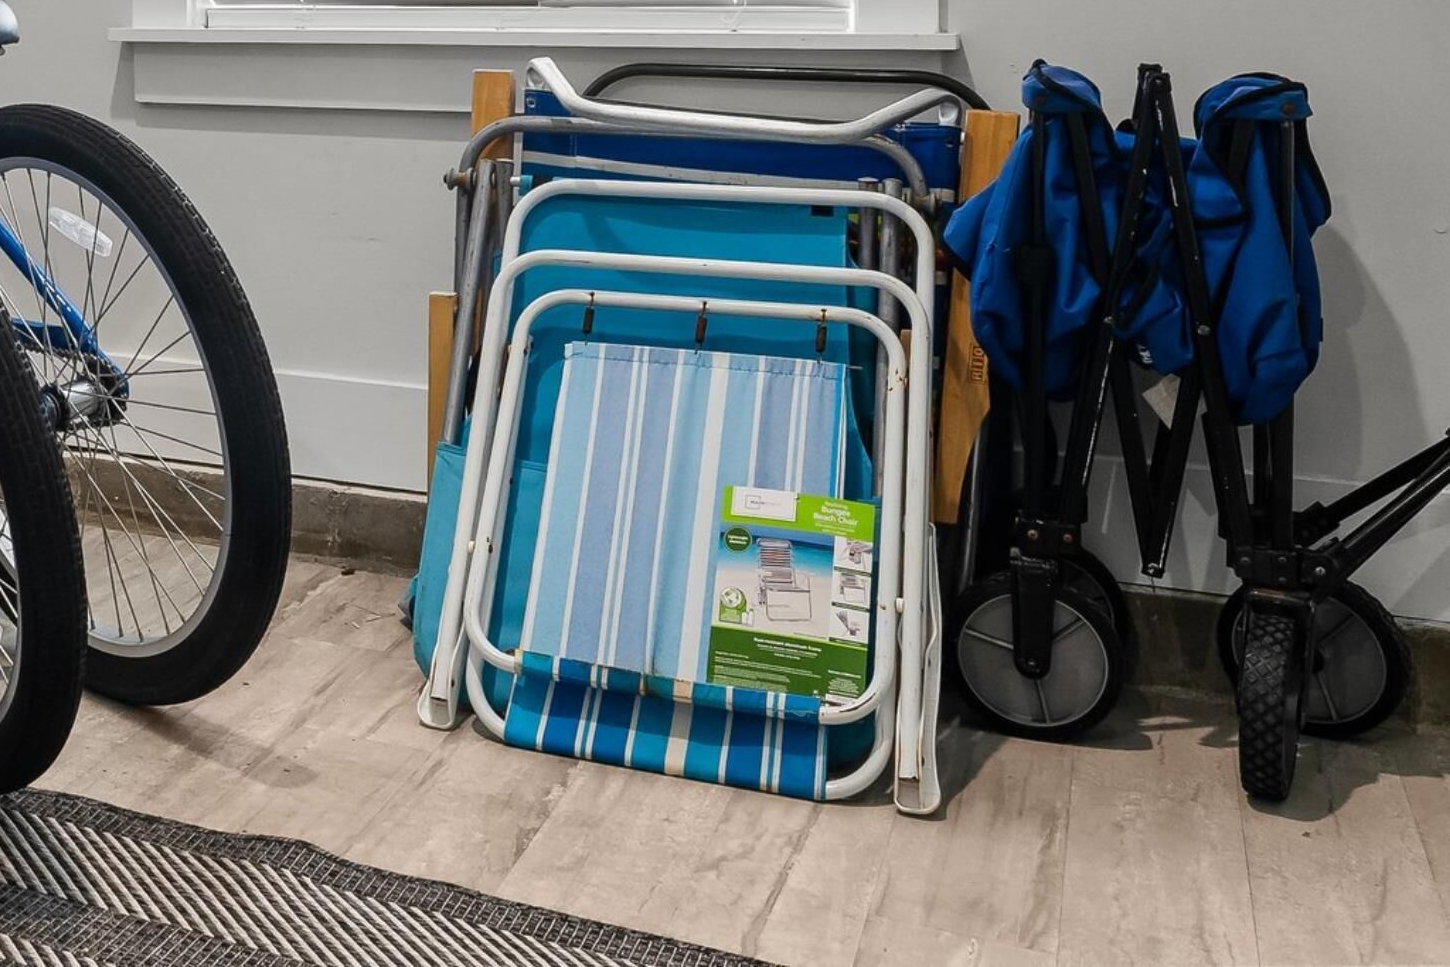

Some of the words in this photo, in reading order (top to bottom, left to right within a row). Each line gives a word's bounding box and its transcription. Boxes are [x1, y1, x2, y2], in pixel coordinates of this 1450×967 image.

[971, 346, 984, 381] RIO
[813, 513, 837, 523] Beach
[838, 516, 859, 526] Chair
